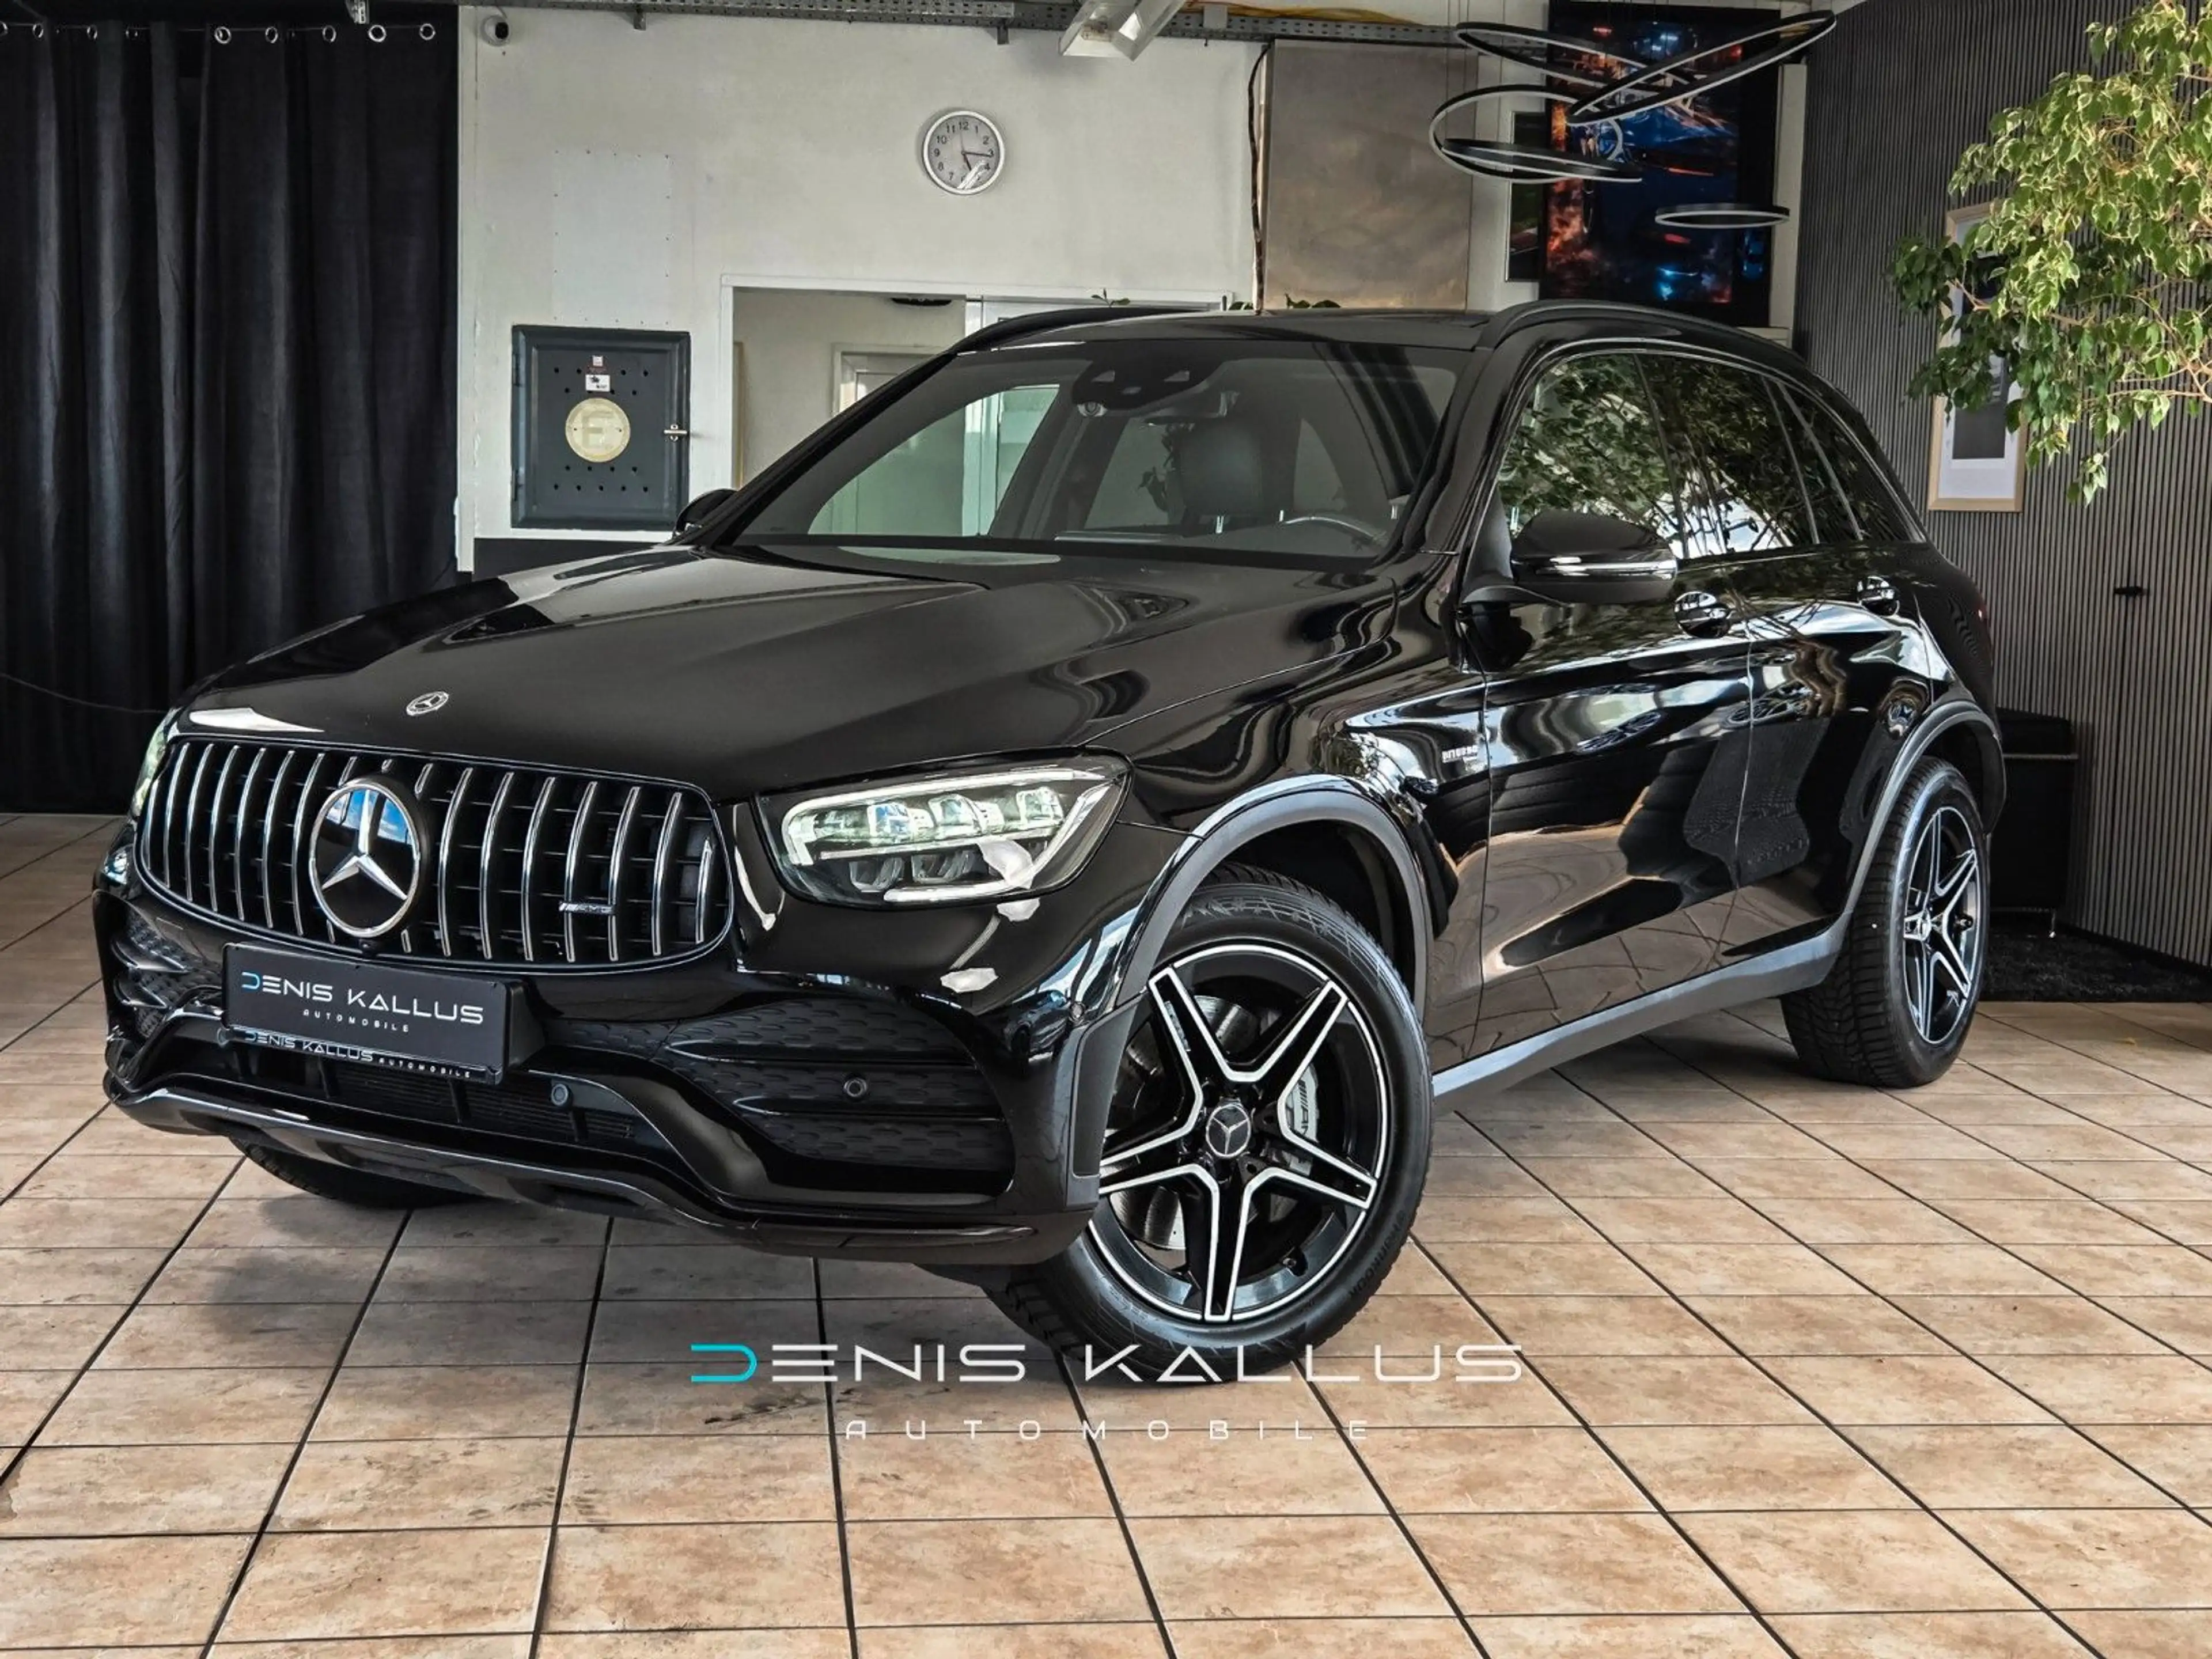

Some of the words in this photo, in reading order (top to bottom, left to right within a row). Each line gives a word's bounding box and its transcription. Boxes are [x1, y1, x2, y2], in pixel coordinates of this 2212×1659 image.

[946, 125, 955, 134] 11
[959, 121, 969, 131] 12
[937, 135, 947, 144] 10
[982, 135, 989, 145] 2
[934, 148, 940, 157] 9
[949, 172, 954, 181] 7
[241, 971, 334, 1002] DENIS
[347, 988, 484, 1026] KALLUS
[303, 1009, 410, 1033] AUTOMOBILE
[244, 1031, 296, 1049] DENIS
[302, 1041, 373, 1062] KALLUS
[378, 1057, 471, 1078] AUTOMOBILE
